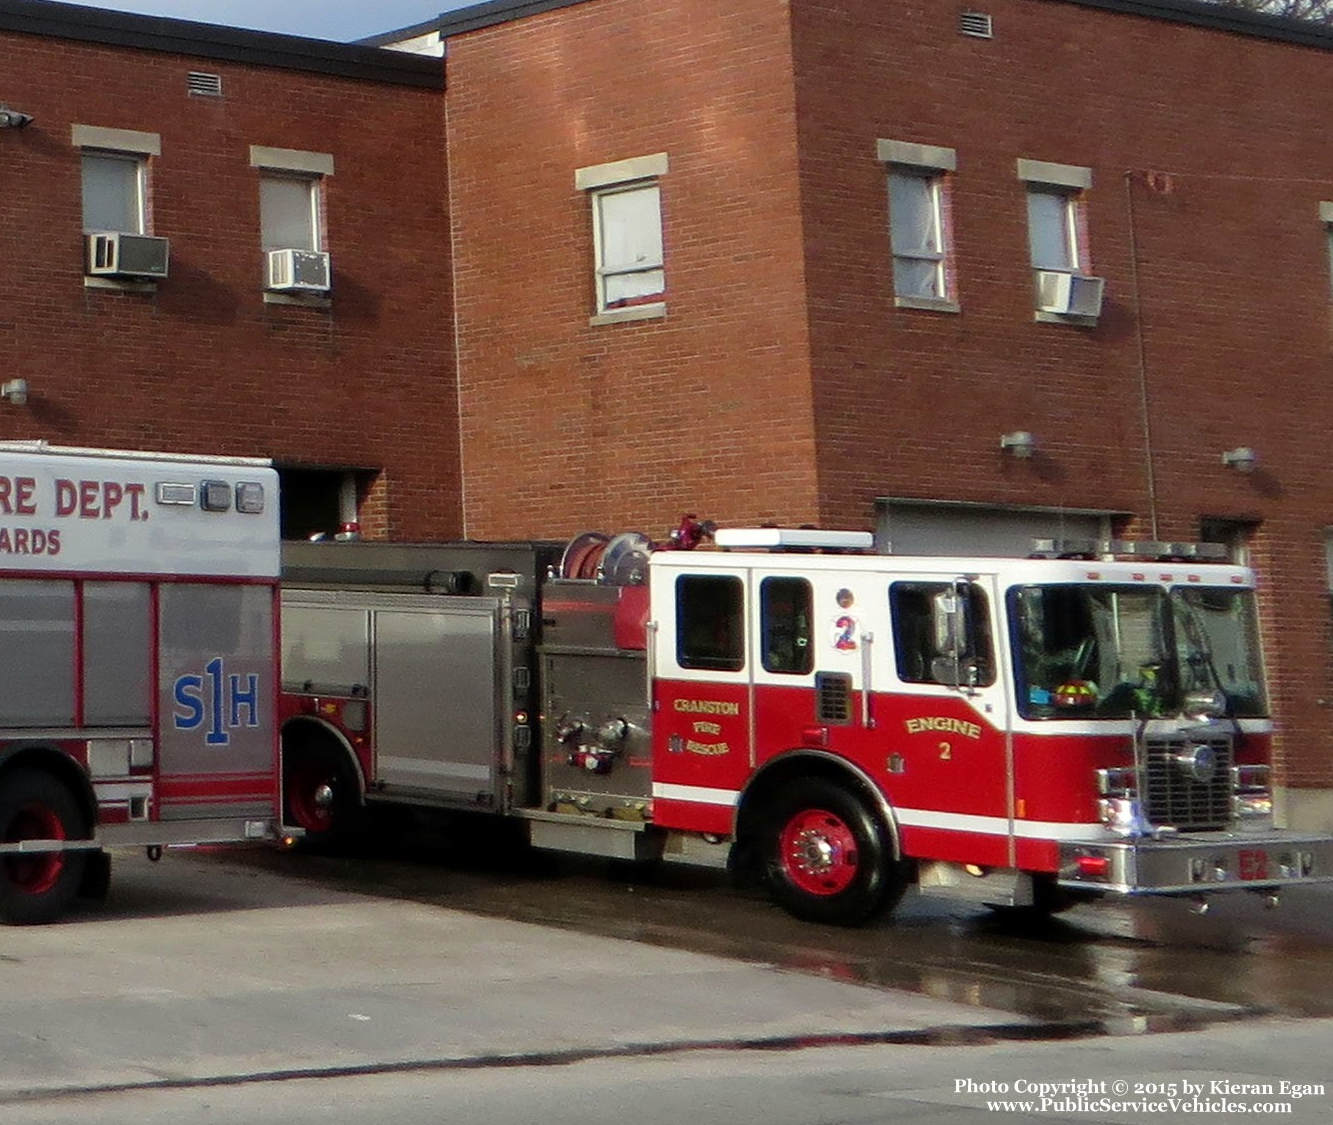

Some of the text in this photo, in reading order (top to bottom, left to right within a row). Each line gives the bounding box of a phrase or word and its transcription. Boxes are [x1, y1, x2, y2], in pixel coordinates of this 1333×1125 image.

[55, 479, 150, 521] DEPT.
[835, 616, 857, 650] 2
[674, 698, 739, 715] CRANSTON
[693, 721, 721, 736] FIRE
[905, 717, 982, 739] ENGINE
[686, 739, 730, 756] RESCUE
[939, 742, 951, 759] 2
[1237, 849, 1268, 880] E2
